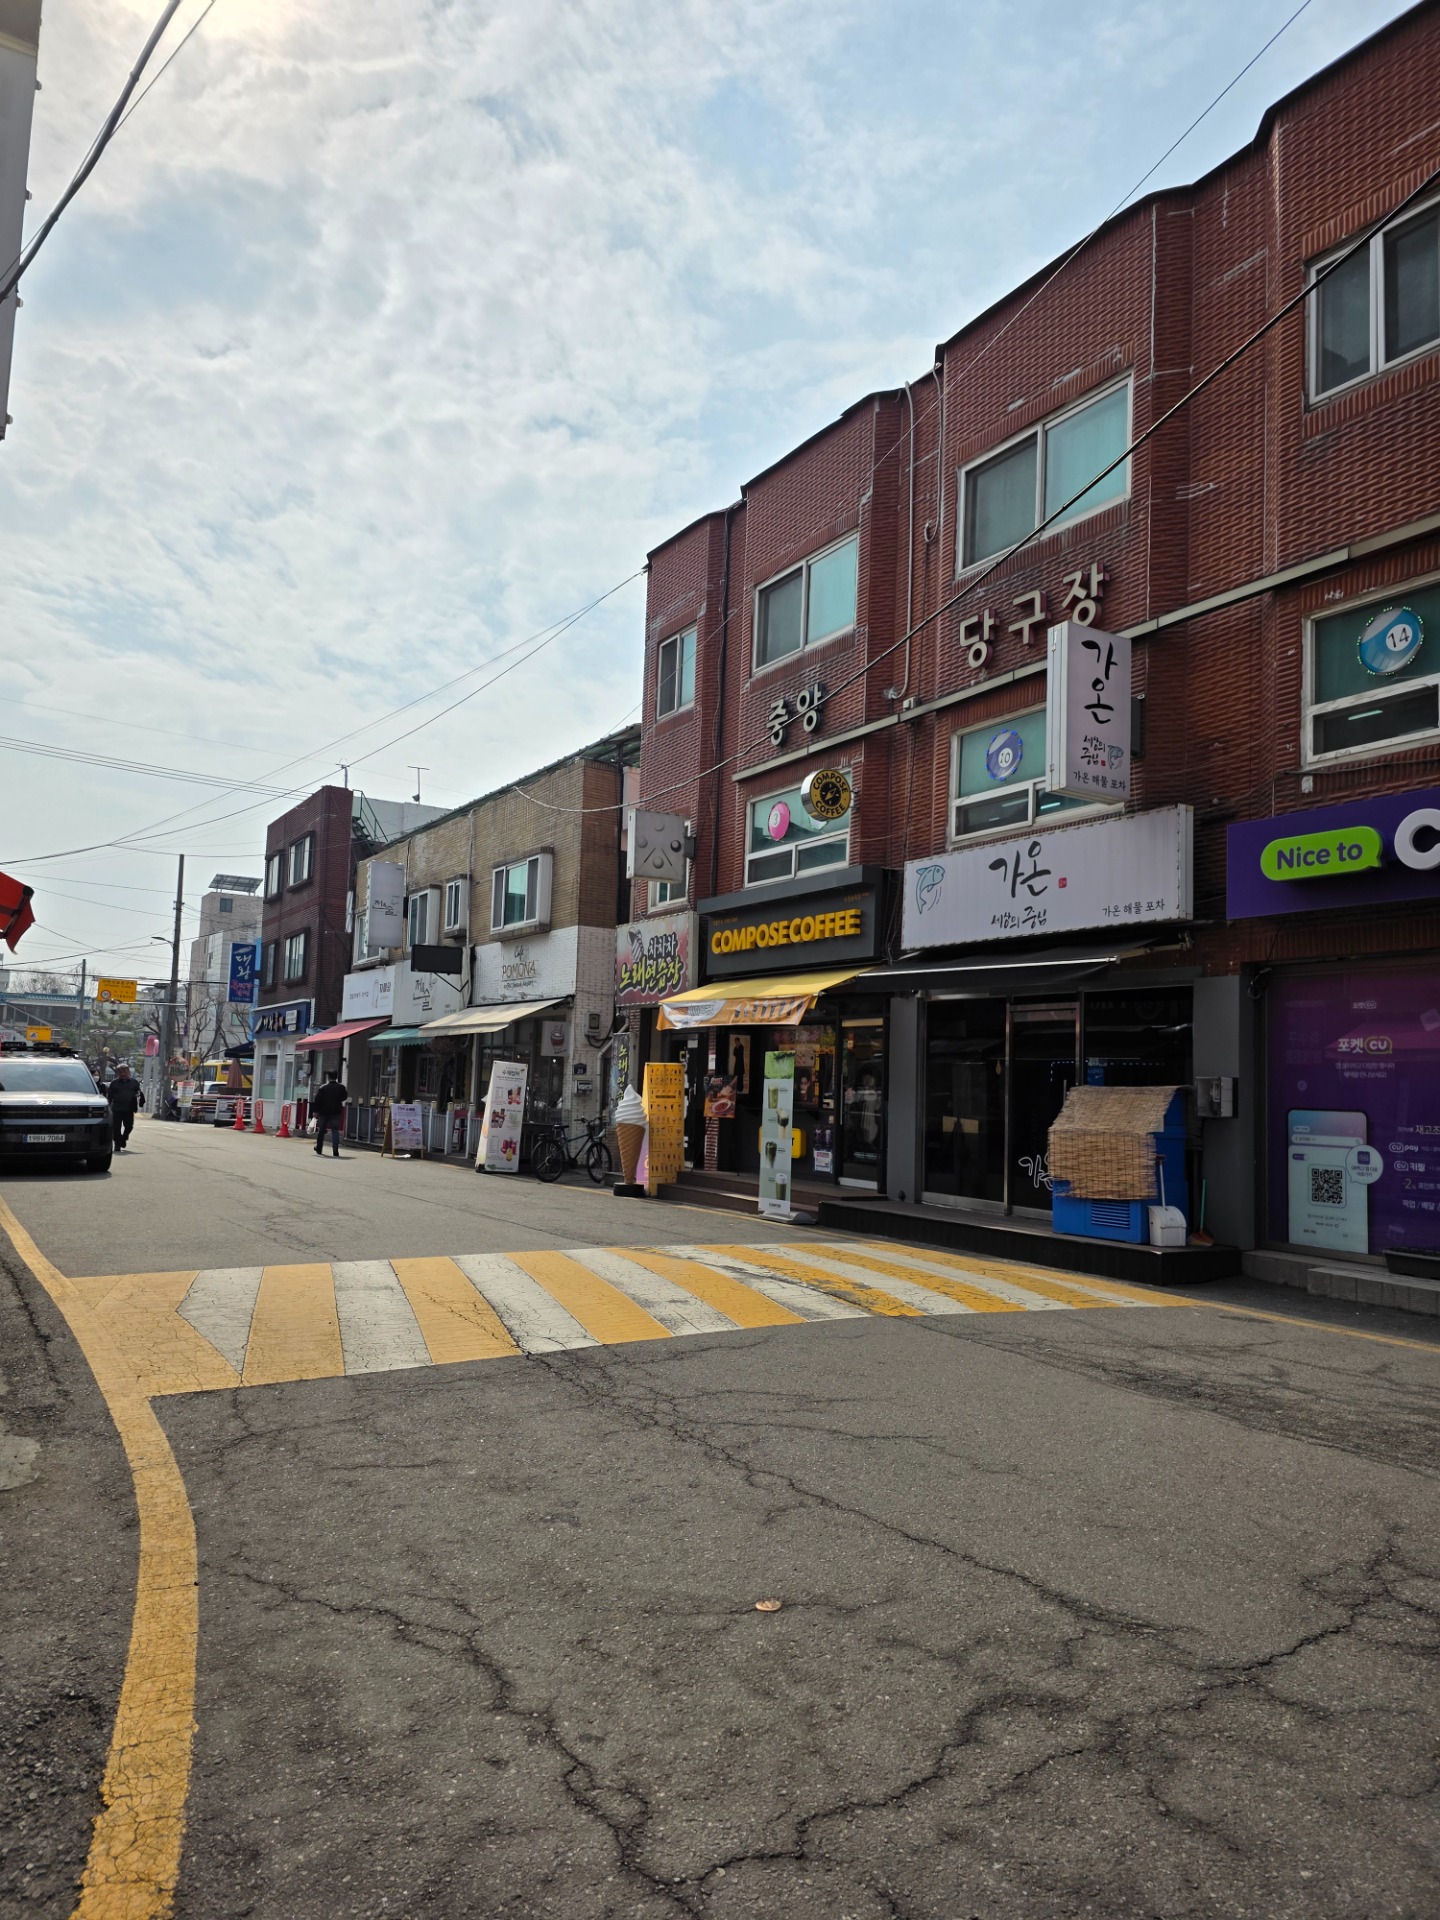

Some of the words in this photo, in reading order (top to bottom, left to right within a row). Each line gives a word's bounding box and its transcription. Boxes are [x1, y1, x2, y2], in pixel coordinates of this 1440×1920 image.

[1387, 627, 1410, 649] 14
[765, 682, 826, 748] 중앙
[959, 562, 1109, 669] 당구장
[1081, 640, 1118, 725] 가온
[1083, 735, 1106, 753] 세상의
[998, 750, 1011, 765] 10
[1080, 747, 1099, 766] 중심
[813, 772, 849, 794] COMPOSE
[1073, 770, 1090, 784] 가온
[1091, 774, 1109, 789] 해물
[1110, 779, 1126, 792] 포차
[815, 800, 846, 816] COFFEE
[1276, 841, 1331, 869] Nice
[1335, 842, 1363, 864] to
[988, 841, 1051, 898] 가온
[991, 911, 1020, 929] 세상의
[1021, 906, 1047, 929] 중심
[1102, 904, 1121, 918] 가온
[1123, 902, 1143, 915] 해물
[1145, 899, 1166, 912] 포차
[648, 932, 678, 959] 차차차
[235, 954, 252, 980] 대왕
[619, 955, 682, 989] 노래연습장
[1018, 1152, 1053, 1191] 가
